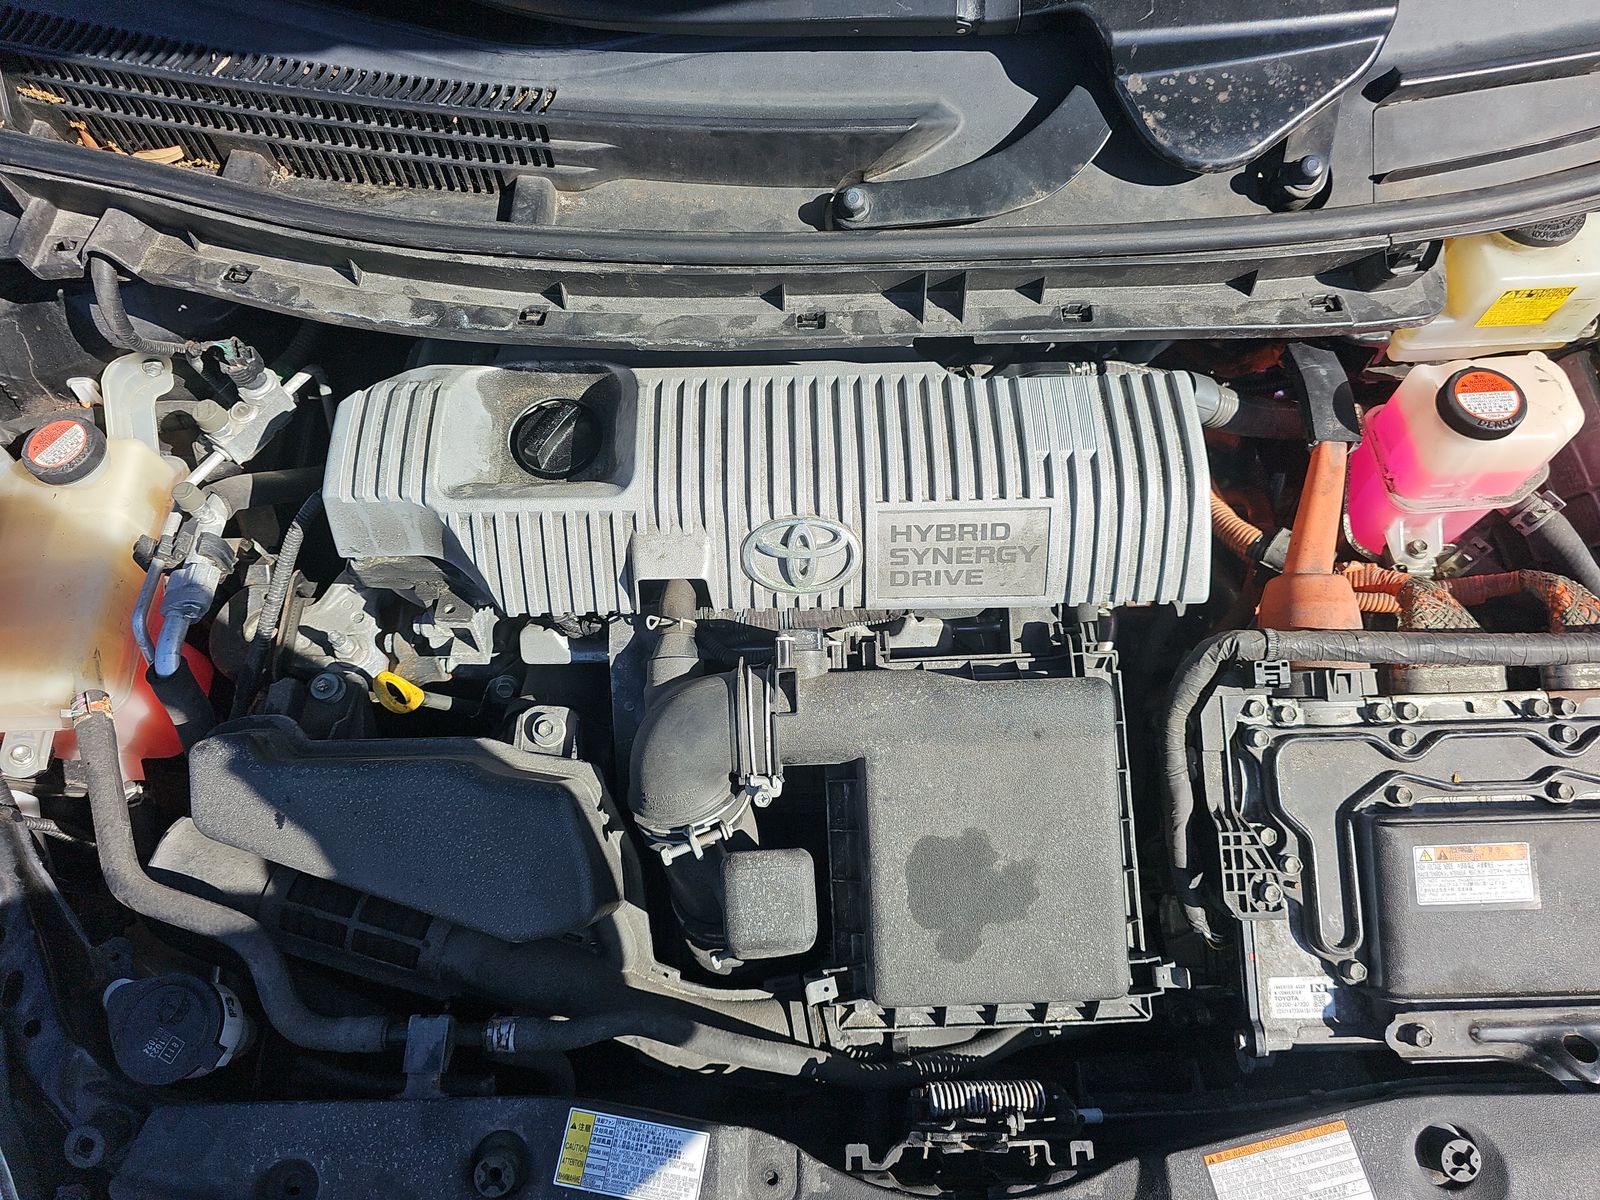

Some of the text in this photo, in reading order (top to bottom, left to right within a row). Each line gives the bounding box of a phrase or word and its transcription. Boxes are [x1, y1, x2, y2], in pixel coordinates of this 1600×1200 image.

[1477, 418, 1516, 429] DENSO
[890, 522, 1011, 543] HYBRID
[889, 545, 1040, 566] SYNERGY
[889, 569, 984, 587] DRIVE
[565, 1141, 587, 1152] CAUTION
[1231, 1143, 1260, 1157] WARNING
[1261, 1131, 1309, 1150] AVERTISSEMENT
[561, 1156, 584, 1167] ATTENTION
